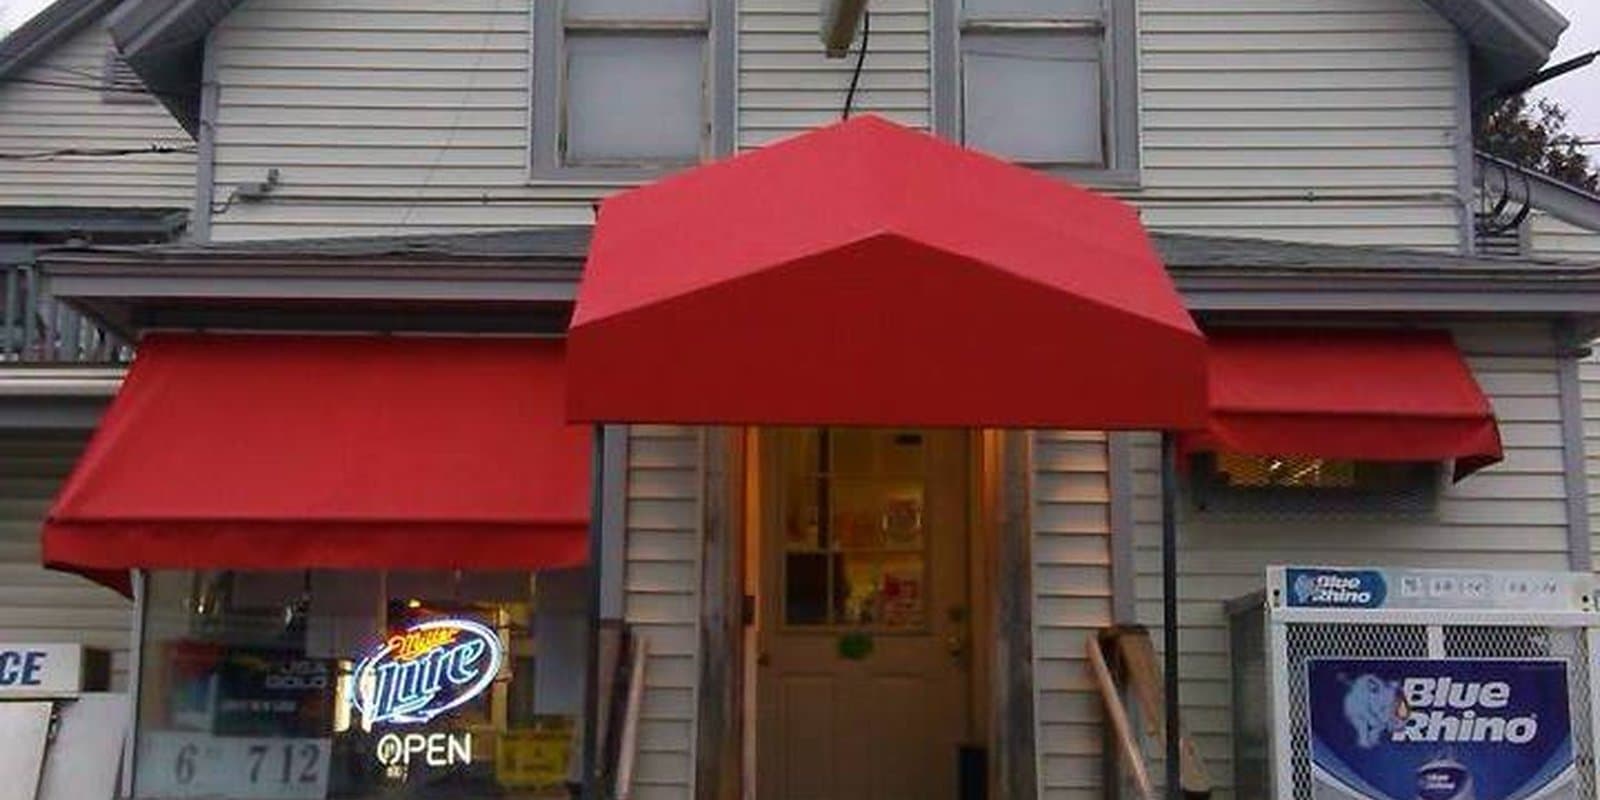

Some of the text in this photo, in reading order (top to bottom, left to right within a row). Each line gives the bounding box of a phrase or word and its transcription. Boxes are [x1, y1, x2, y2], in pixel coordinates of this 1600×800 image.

[1403, 677, 1510, 709] Blue
[1391, 710, 1538, 744] Rhino
[376, 732, 471, 766] OPEN
